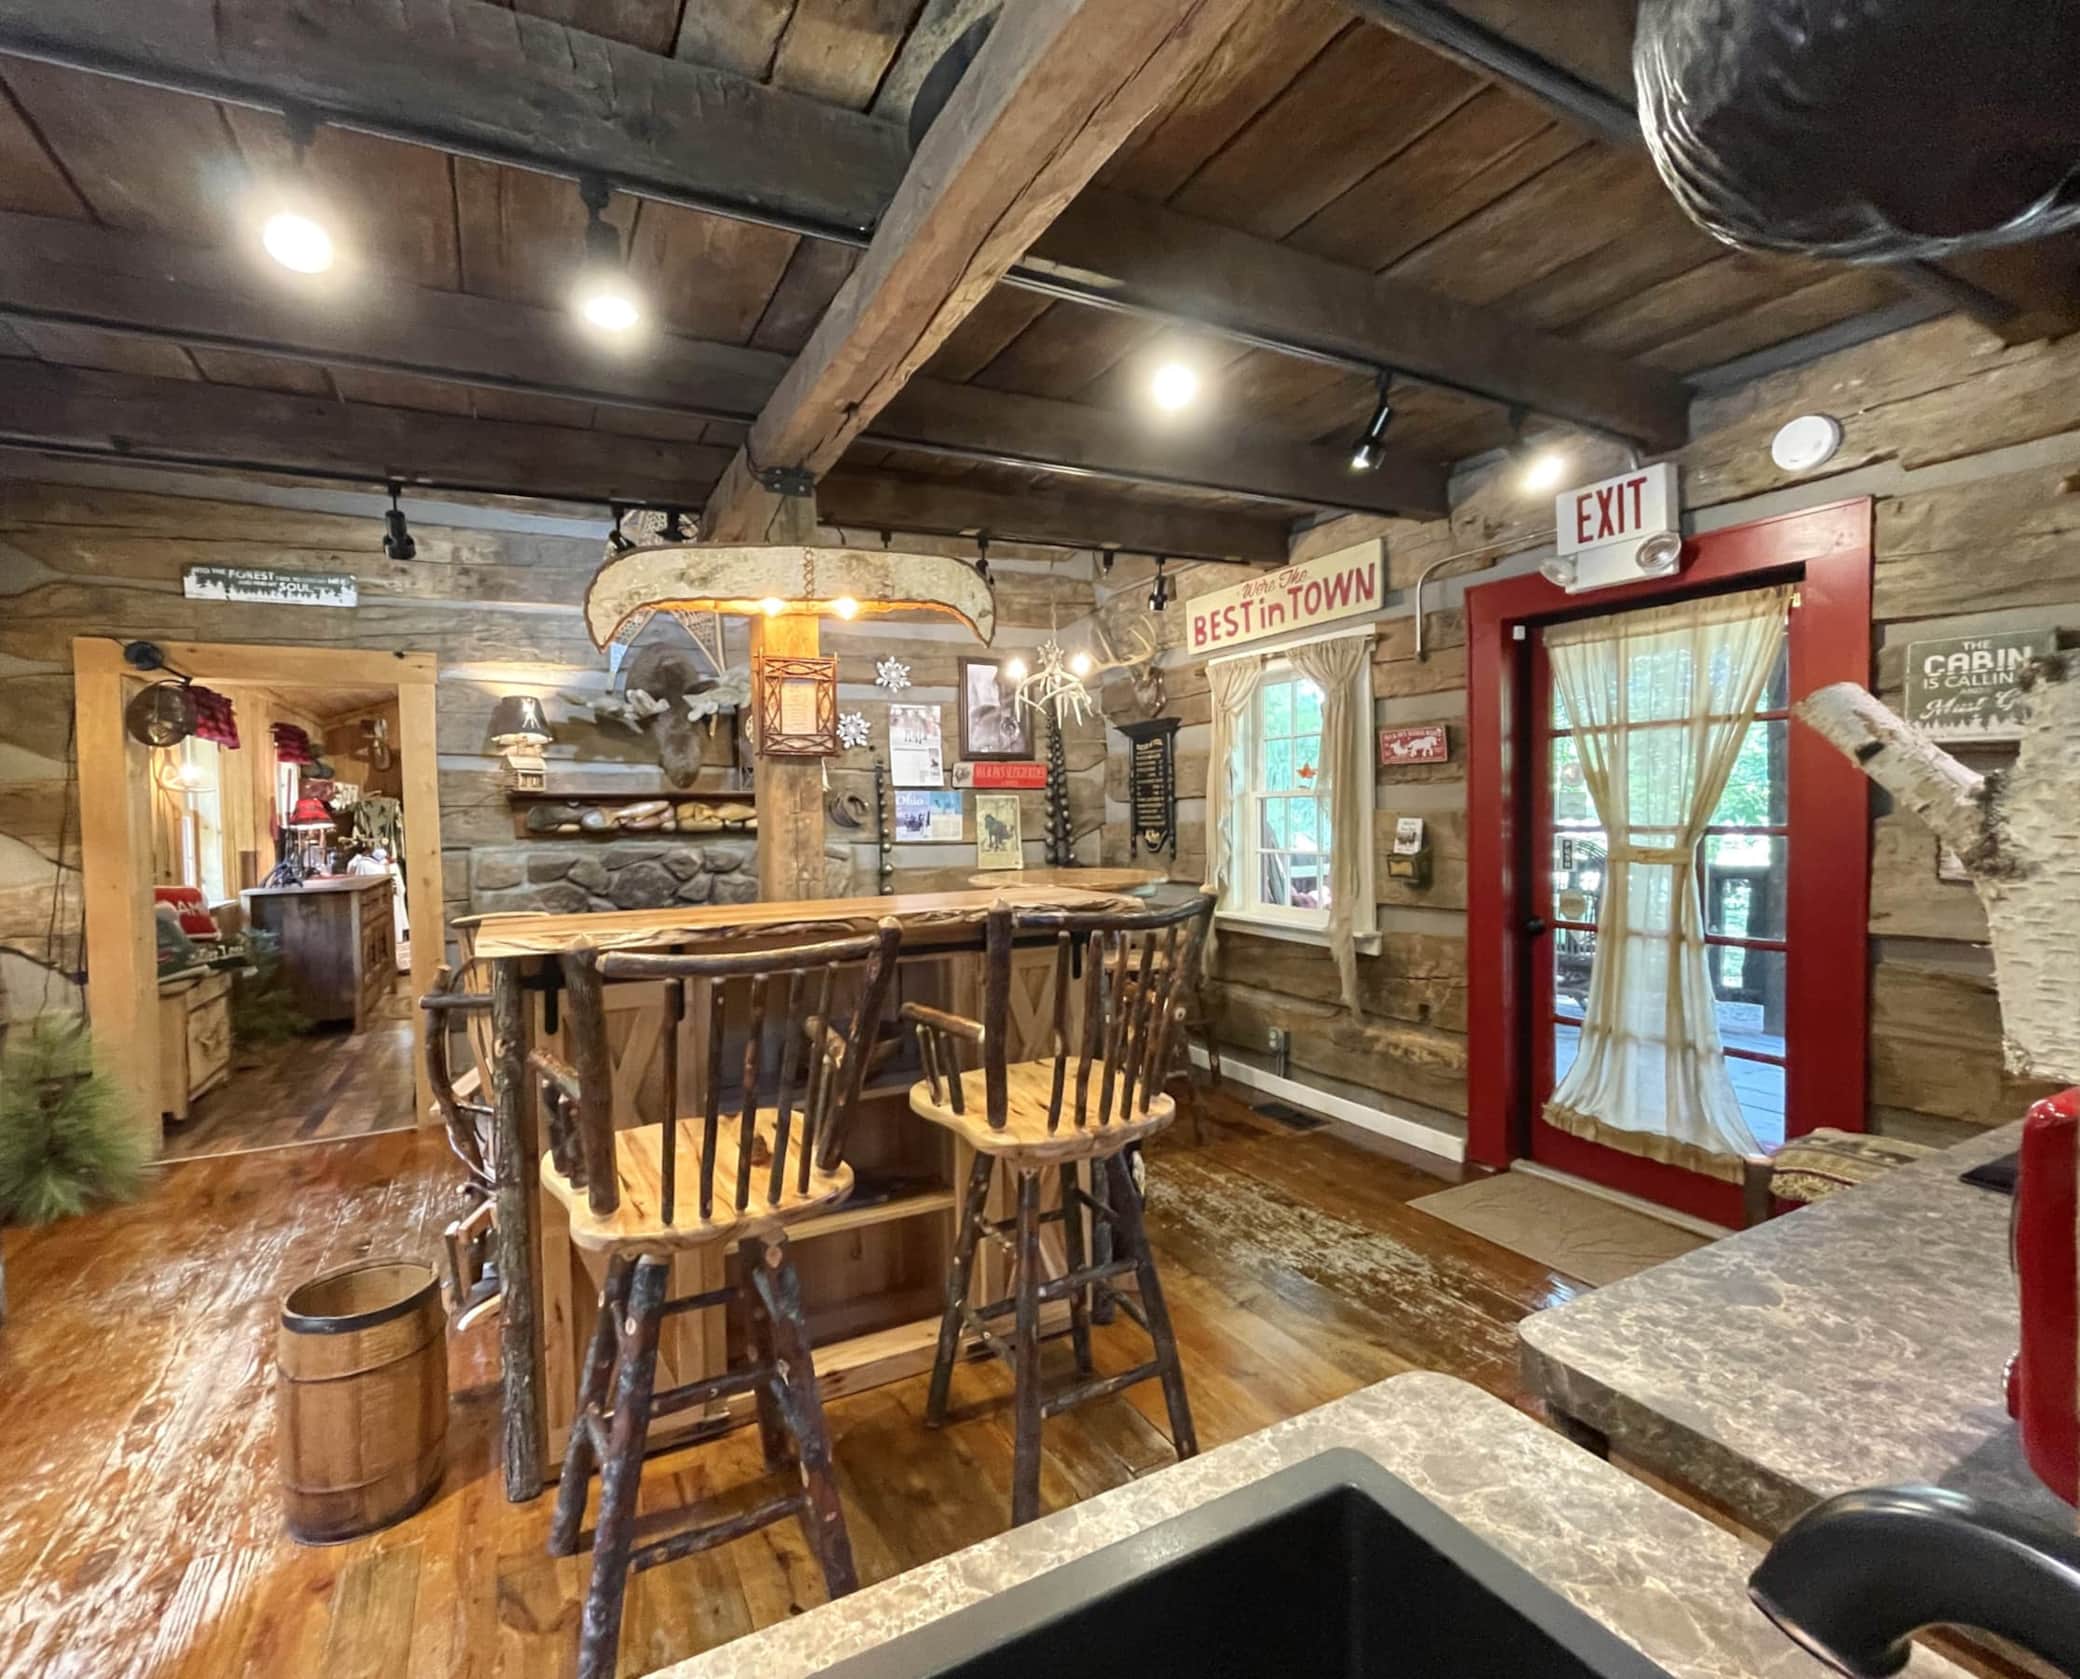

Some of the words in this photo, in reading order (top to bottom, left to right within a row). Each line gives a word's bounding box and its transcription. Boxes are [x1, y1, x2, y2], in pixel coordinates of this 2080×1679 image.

[1576, 476, 1648, 544] EXIT
[228, 569, 274, 581] FOREST
[279, 582, 311, 593] SOUL
[1194, 600, 1254, 647] BEST
[1259, 597, 1286, 629] in
[1287, 562, 1376, 621] TOWN
[1962, 639, 1993, 651] THE
[1924, 646, 2033, 677] CABIN
[1923, 678, 1940, 690] IS
[1944, 672, 2015, 688] CALLIN
[1919, 692, 1990, 720] Must
